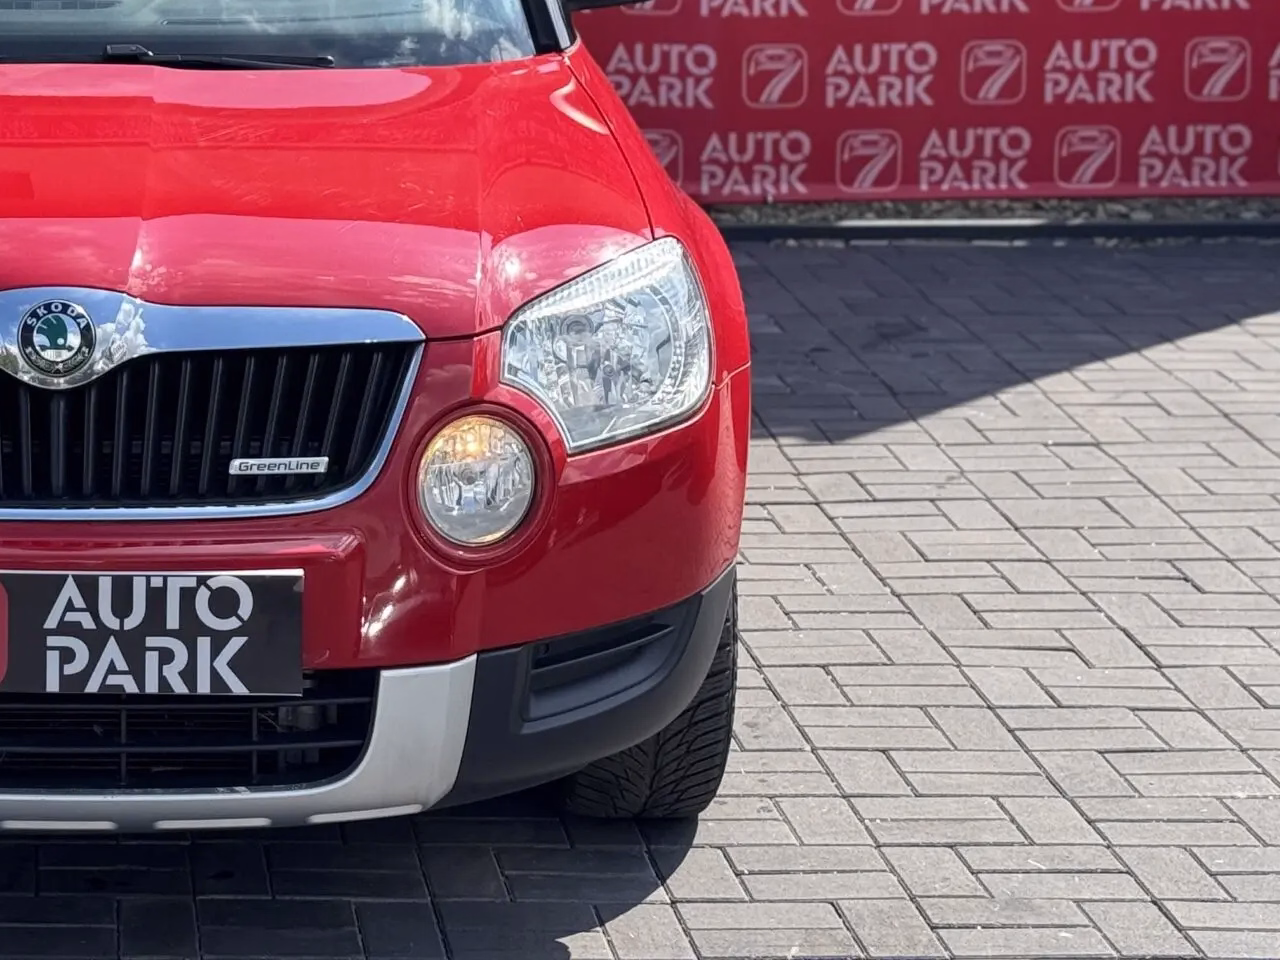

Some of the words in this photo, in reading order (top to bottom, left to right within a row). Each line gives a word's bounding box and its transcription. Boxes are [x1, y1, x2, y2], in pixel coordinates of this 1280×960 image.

[606, 42, 717, 75] AUTO
[826, 42, 937, 74] AUTO
[1044, 38, 1157, 71] AUTO
[826, 75, 932, 107] PARK
[1045, 71, 1152, 103] PARK
[701, 131, 810, 162] AUTO
[920, 127, 1030, 158] AUTO
[1140, 124, 1251, 155] AUTO
[700, 163, 808, 197] PARK
[920, 160, 1029, 192] PARK
[1139, 157, 1247, 188] PARK
[238, 461, 320, 472] GreenLine
[43, 574, 254, 631] AUTO
[46, 636, 251, 693] PARK
